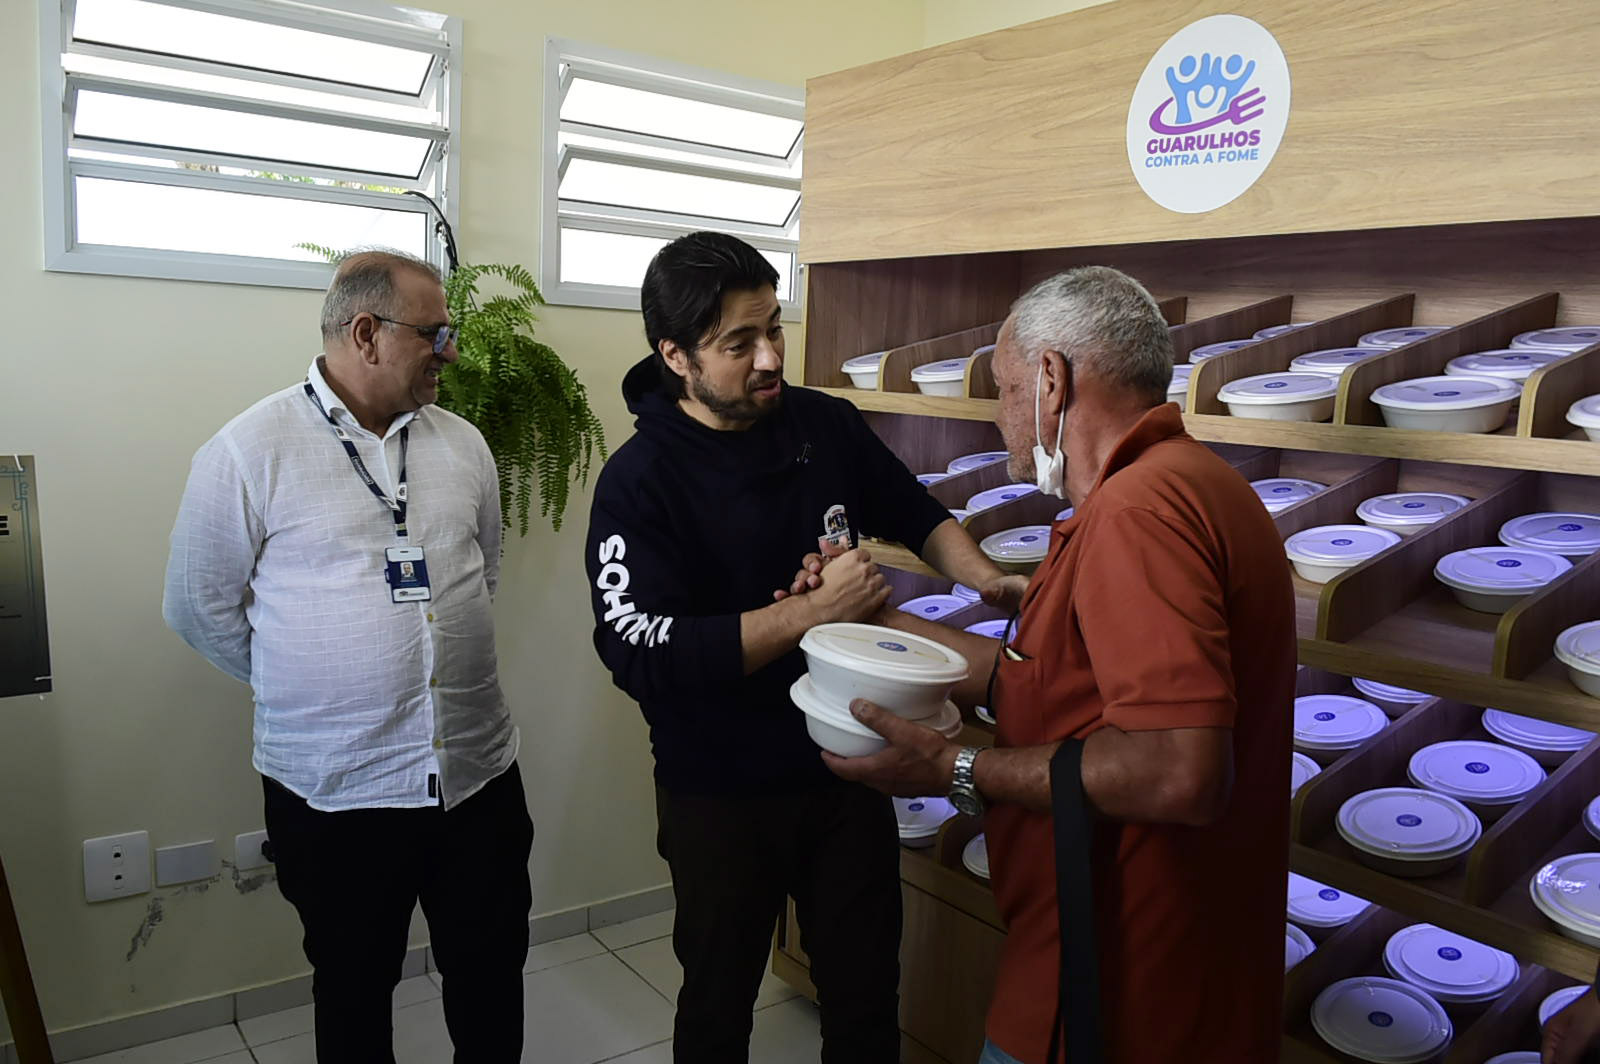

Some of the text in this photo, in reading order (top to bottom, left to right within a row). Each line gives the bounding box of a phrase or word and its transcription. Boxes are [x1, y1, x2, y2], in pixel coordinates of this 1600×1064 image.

[1146, 129, 1261, 154] GUARULHOS
[1145, 148, 1259, 168] CONTRA A FOME
